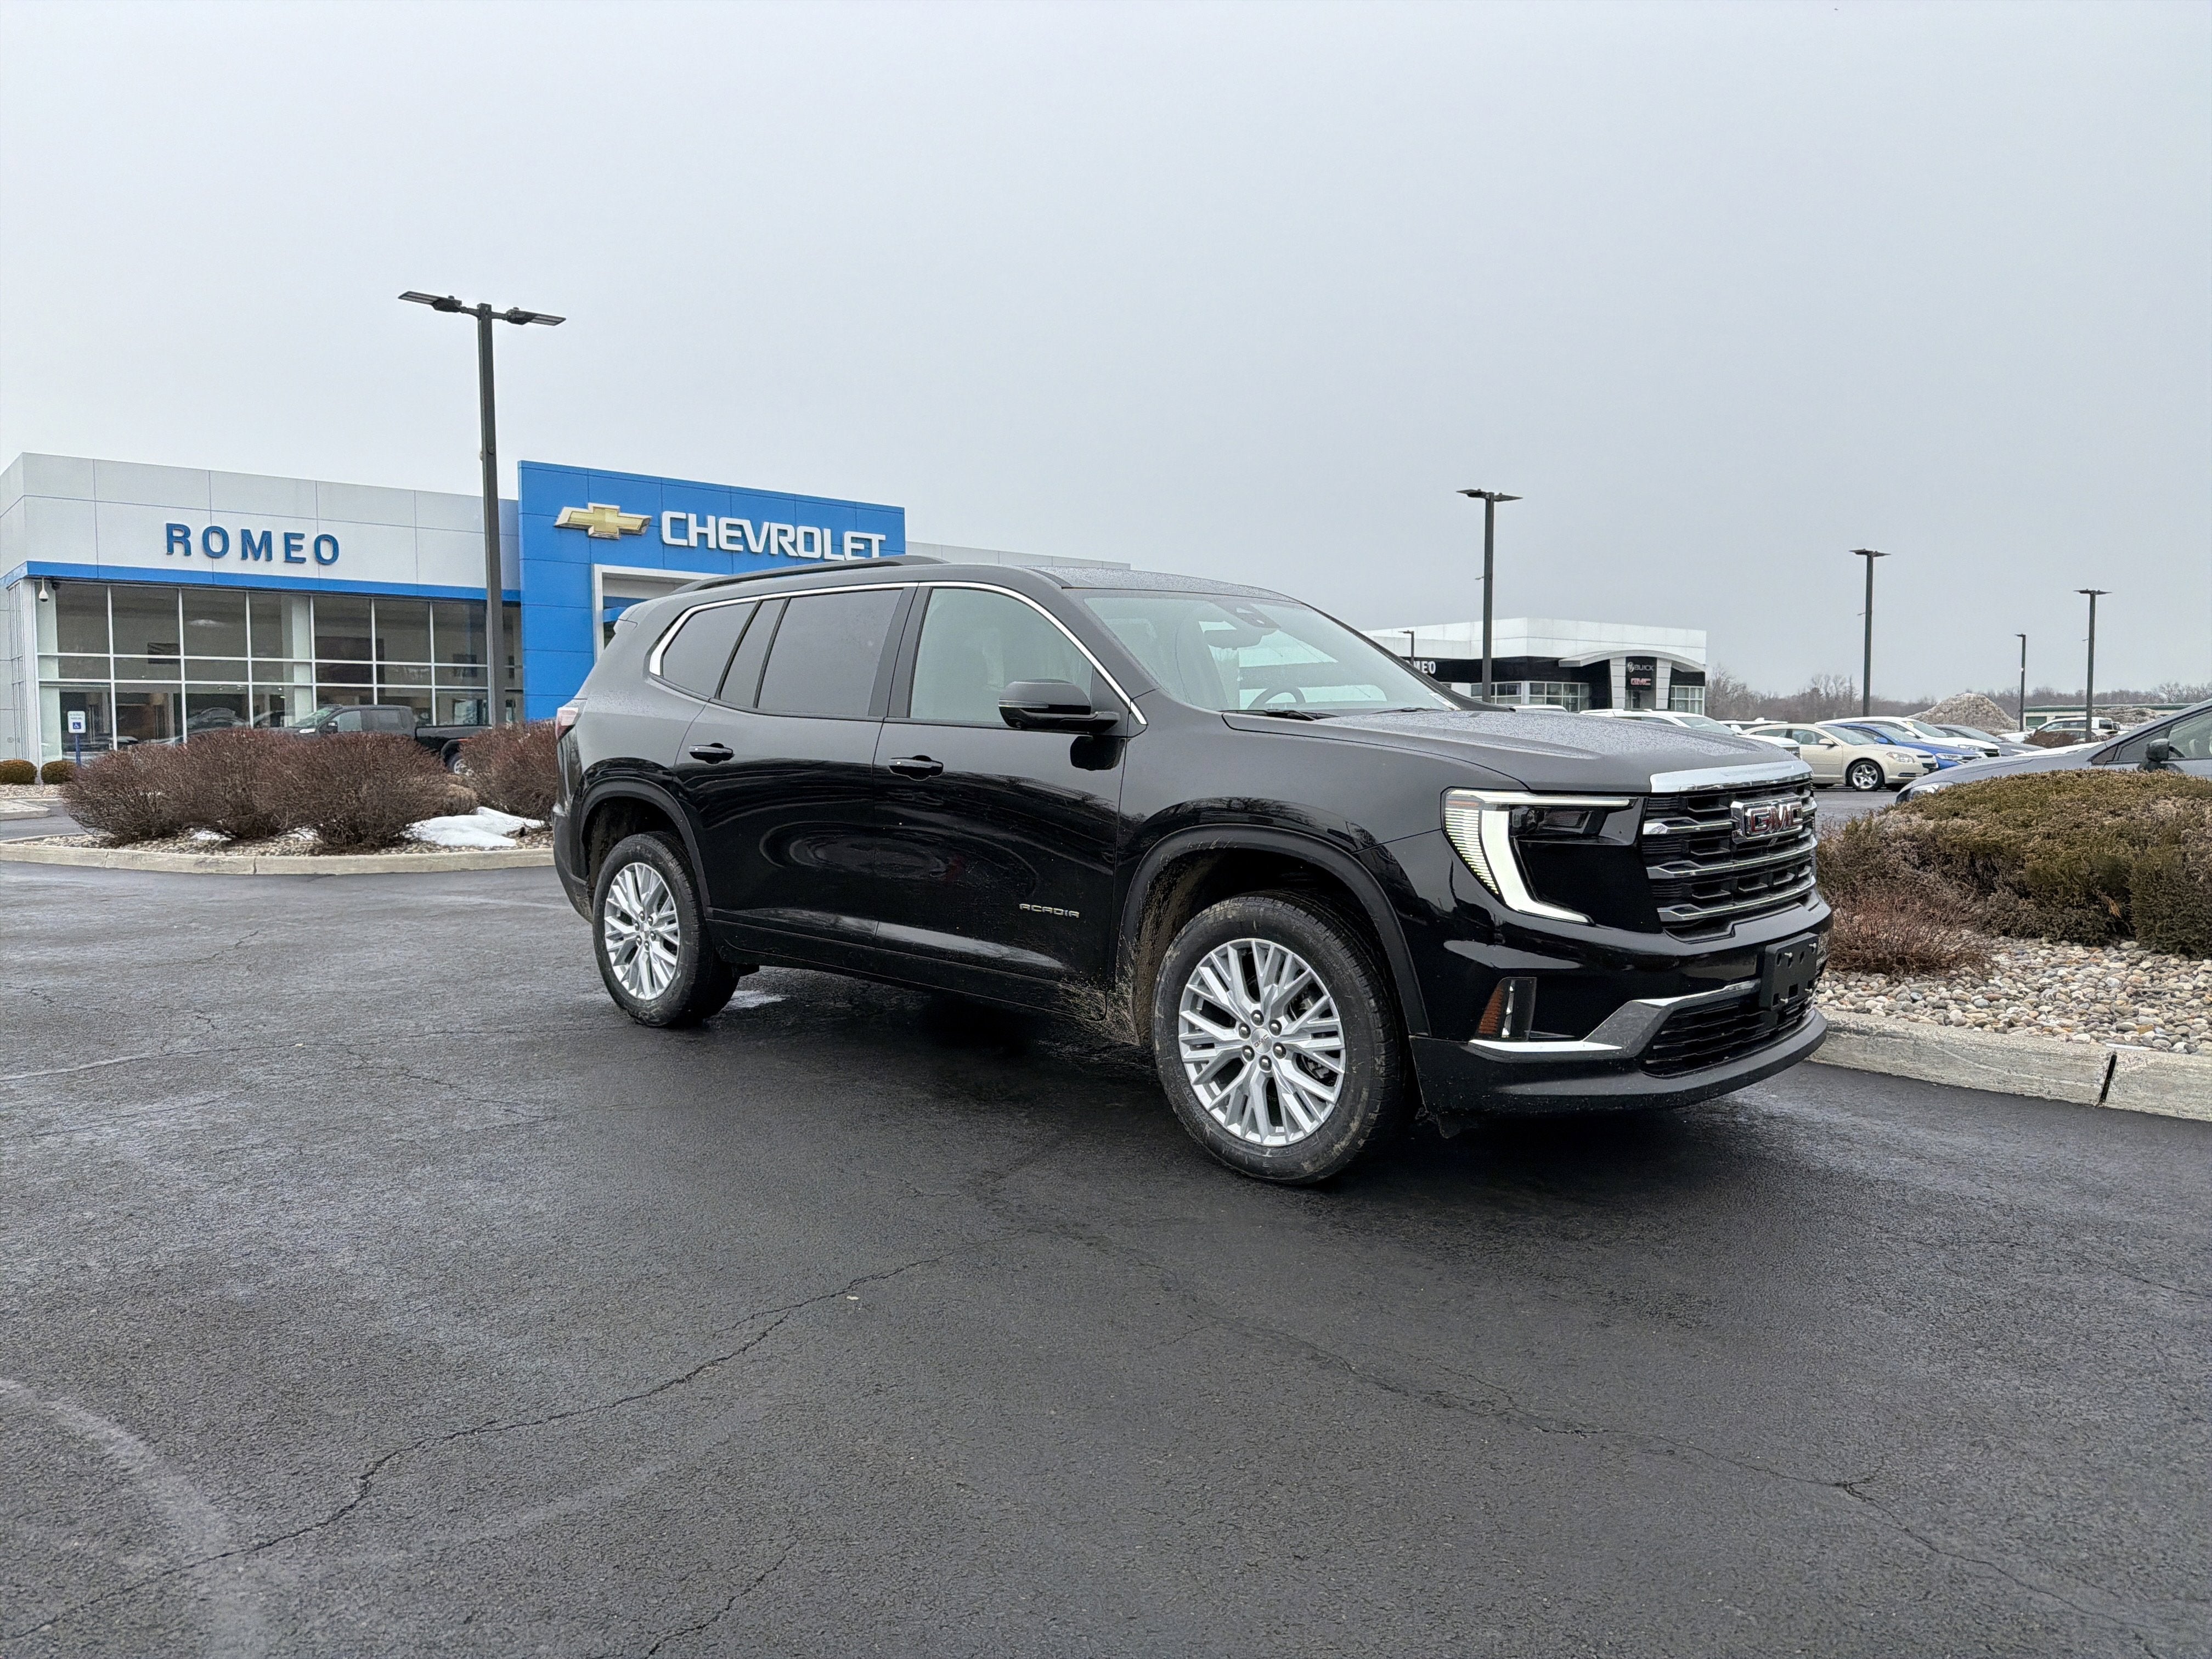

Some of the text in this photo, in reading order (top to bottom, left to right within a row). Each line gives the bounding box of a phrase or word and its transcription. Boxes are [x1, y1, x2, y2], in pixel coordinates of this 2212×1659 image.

[661, 510, 886, 561] CHEVROLET
[166, 522, 340, 566] ROMEO
[1405, 660, 1436, 674] MEO
[1630, 678, 1651, 686] GMC
[1745, 801, 1804, 834] GMC
[1019, 903, 1080, 918] ACADIA
[1254, 1034, 1269, 1048] GMC
